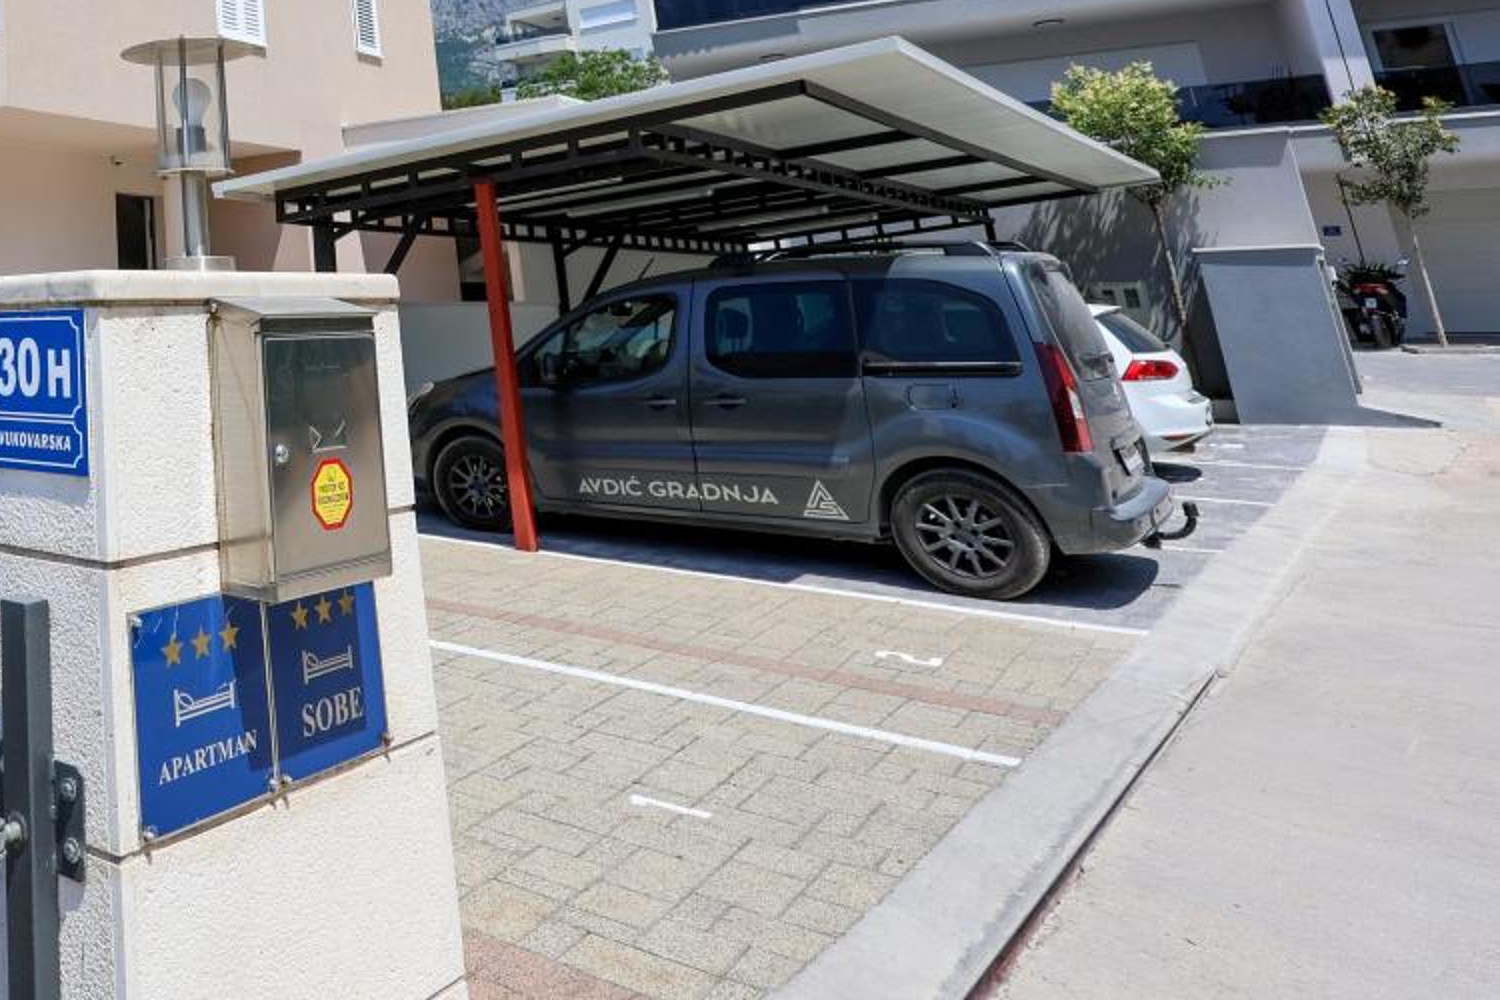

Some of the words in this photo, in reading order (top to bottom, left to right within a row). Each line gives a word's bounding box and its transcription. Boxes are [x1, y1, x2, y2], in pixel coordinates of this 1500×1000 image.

[647, 480, 779, 505] GRADNJA
[302, 687, 363, 737] SOBE
[159, 729, 257, 785] APARTMAN
